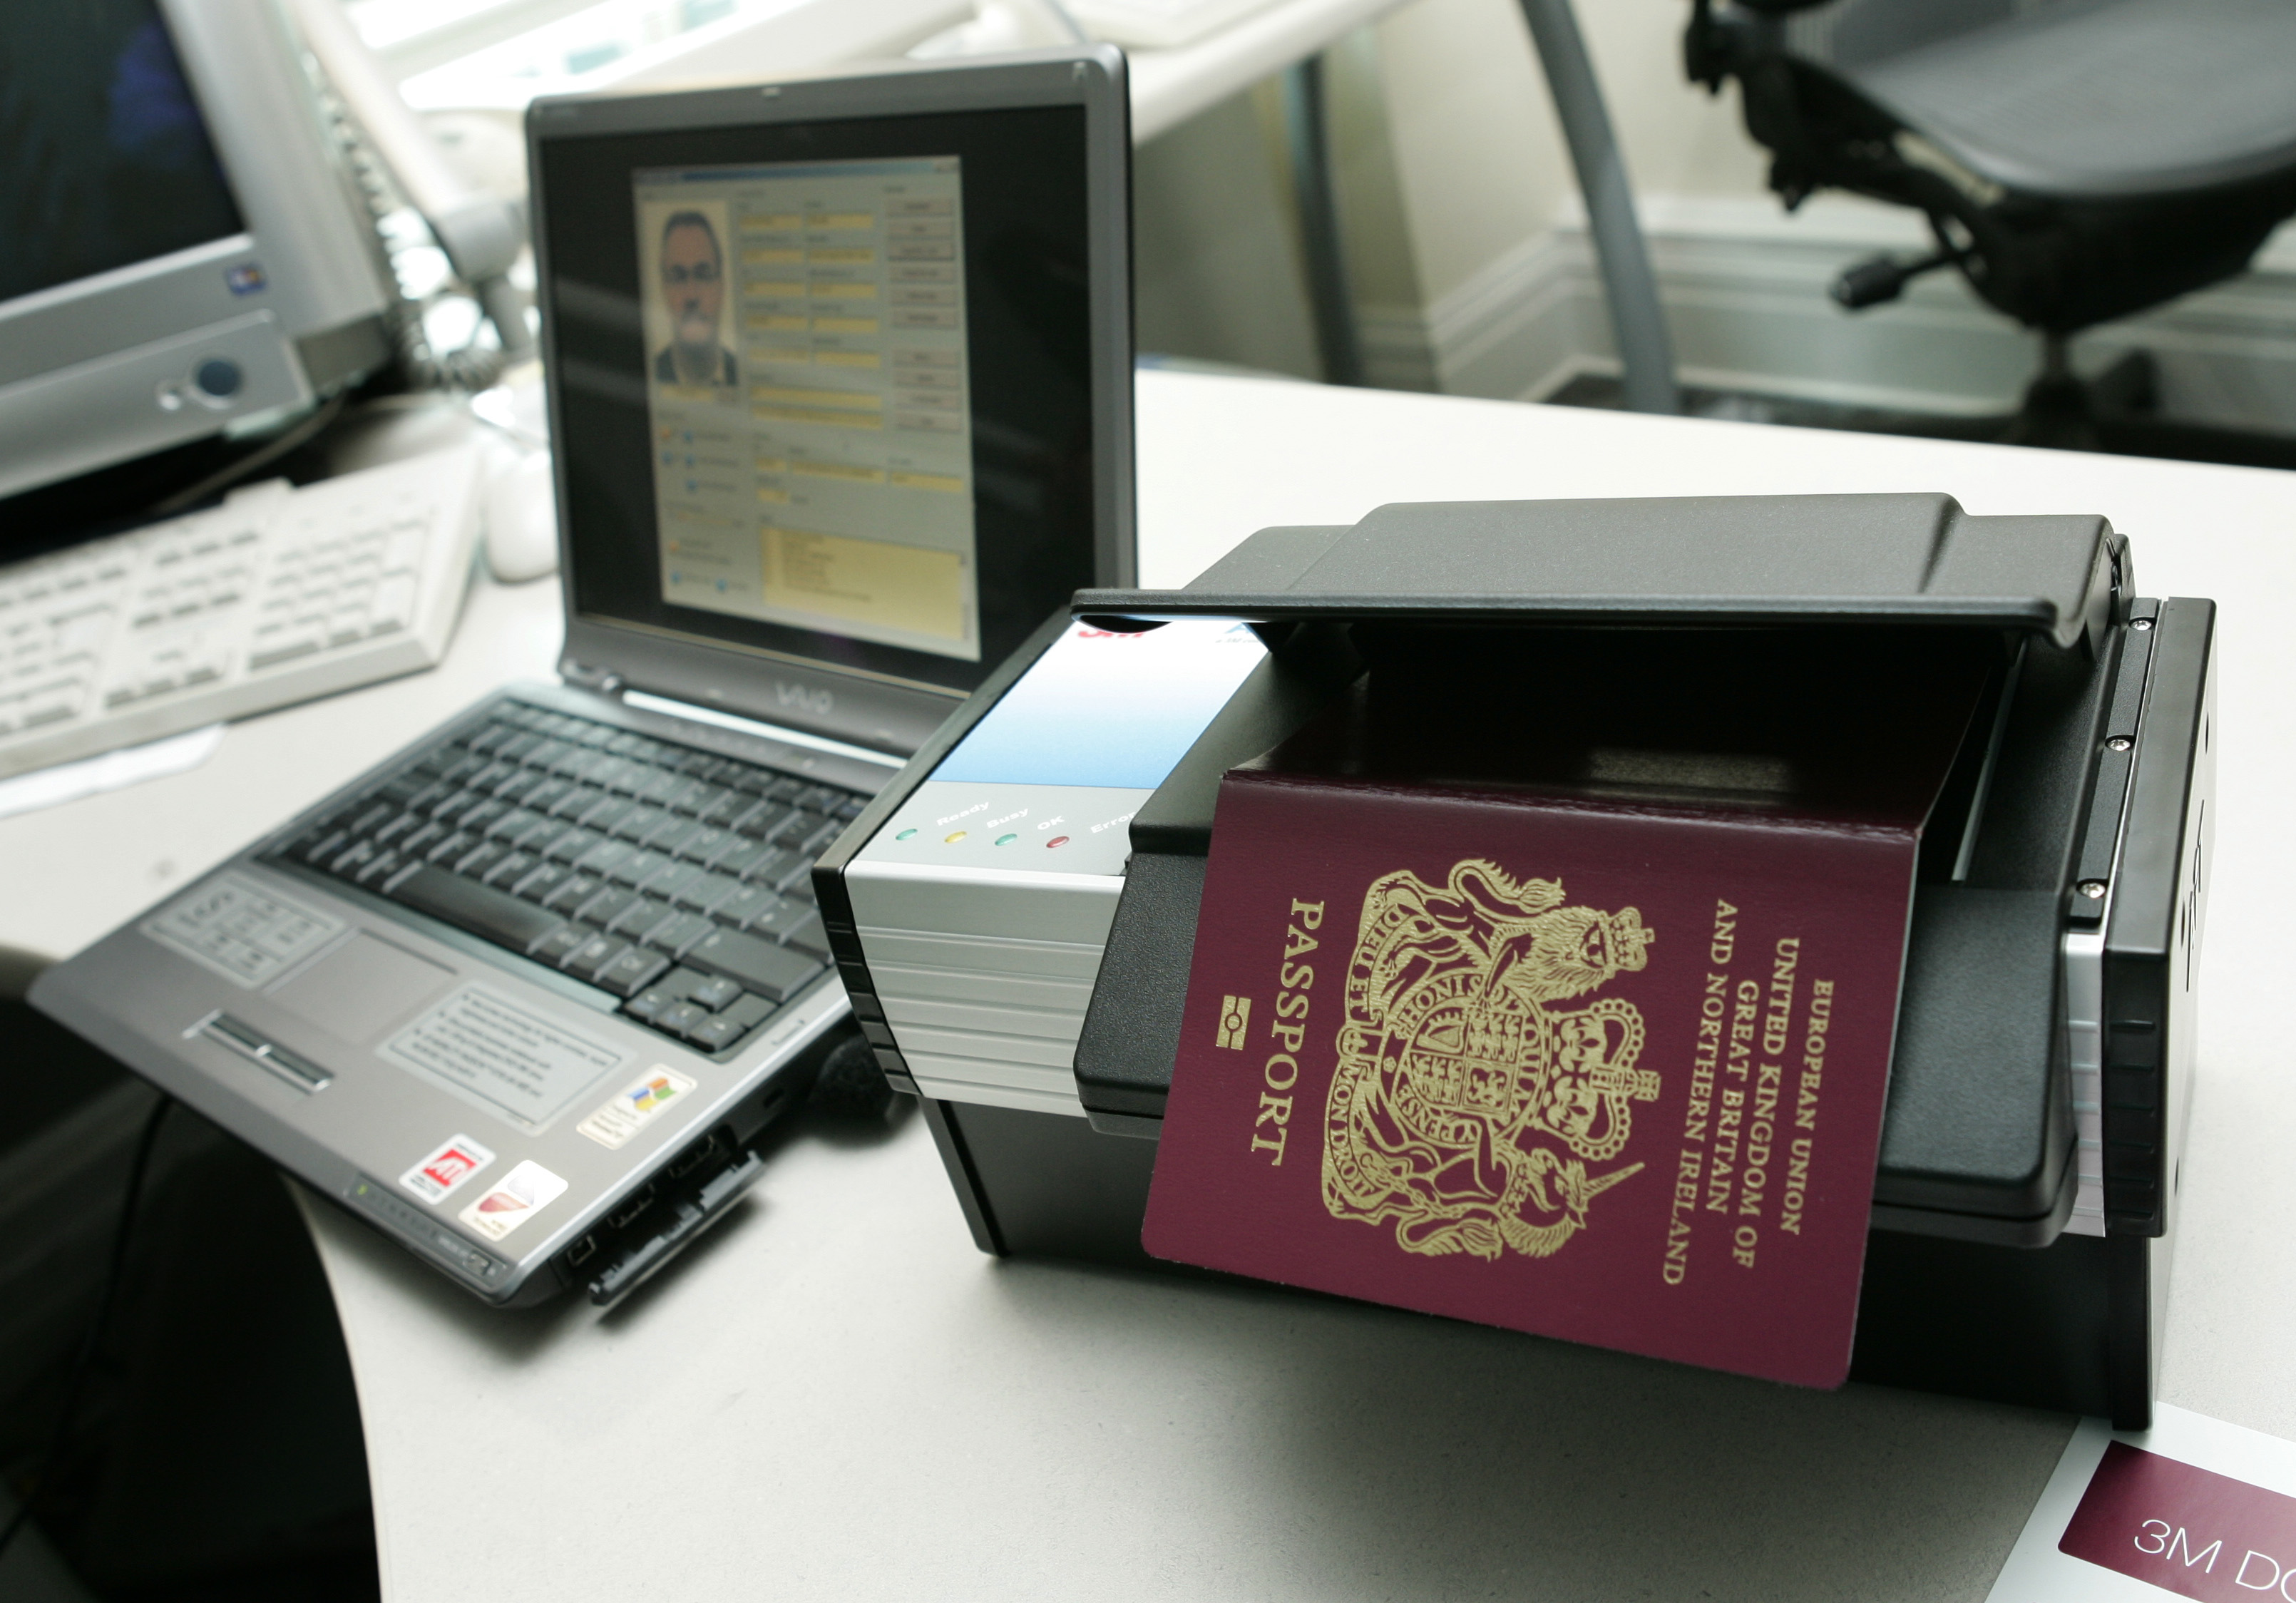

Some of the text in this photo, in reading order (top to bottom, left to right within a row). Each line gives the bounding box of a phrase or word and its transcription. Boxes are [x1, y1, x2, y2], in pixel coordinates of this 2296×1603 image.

[936, 802, 990, 826] Ready
[986, 807, 1029, 829] Busy
[1037, 815, 1065, 831] OK
[1090, 811, 1137, 834] Error
[1251, 898, 1324, 1166] PASSPORT
[1663, 898, 1738, 1285] AND NORTHERN IRELAND
[1706, 979, 1760, 1214] GREAT BRITAIN
[1733, 937, 1799, 1269] UNITED KINGDOM OF
[1780, 978, 1834, 1235] EUROPEAN UNION
[2134, 1520, 2223, 1574] 3M
